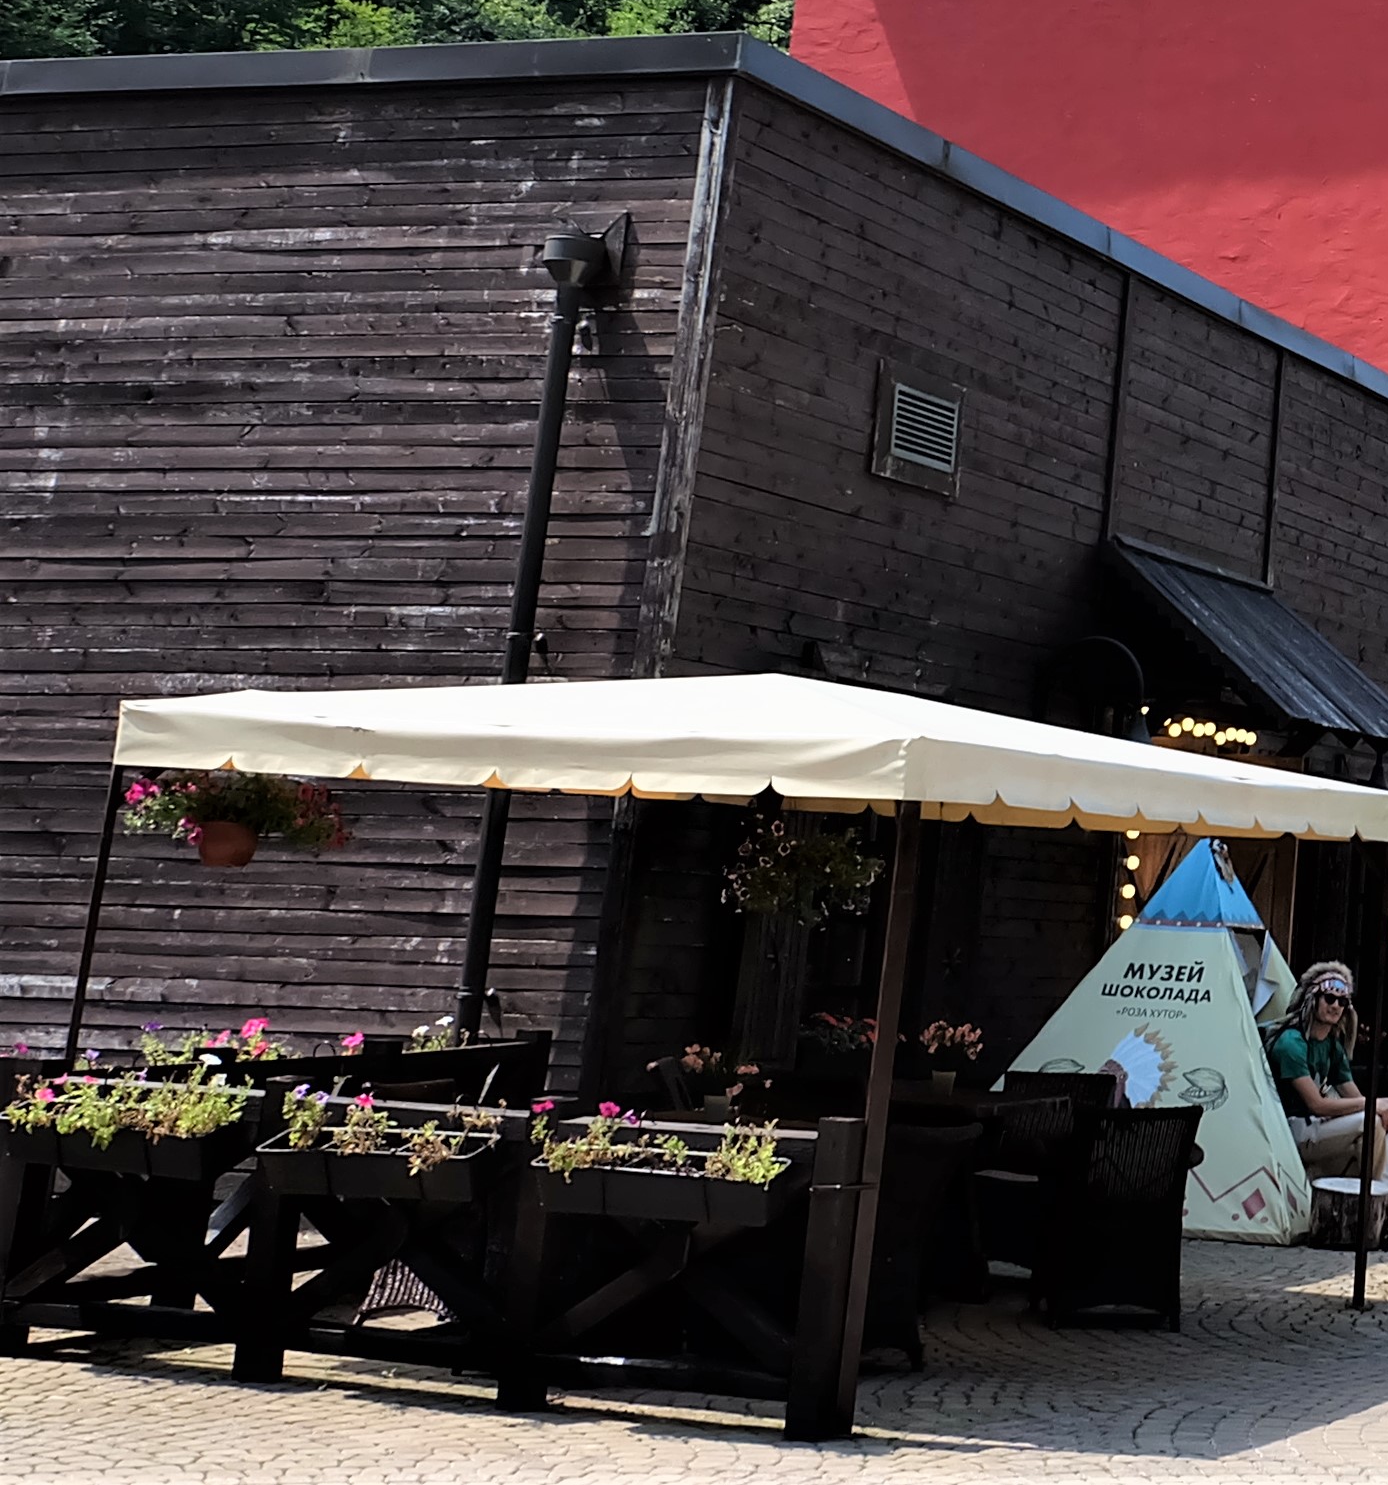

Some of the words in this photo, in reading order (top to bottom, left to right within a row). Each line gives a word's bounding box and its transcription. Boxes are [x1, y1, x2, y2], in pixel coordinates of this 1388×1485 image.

[1123, 961, 1205, 983] МУЗЕЙ
[1101, 983, 1211, 1004] ШОКОЛАДА
[1116, 1006, 1147, 1017] «РОЗА
[1149, 1008, 1187, 1019] ХУТОР»
